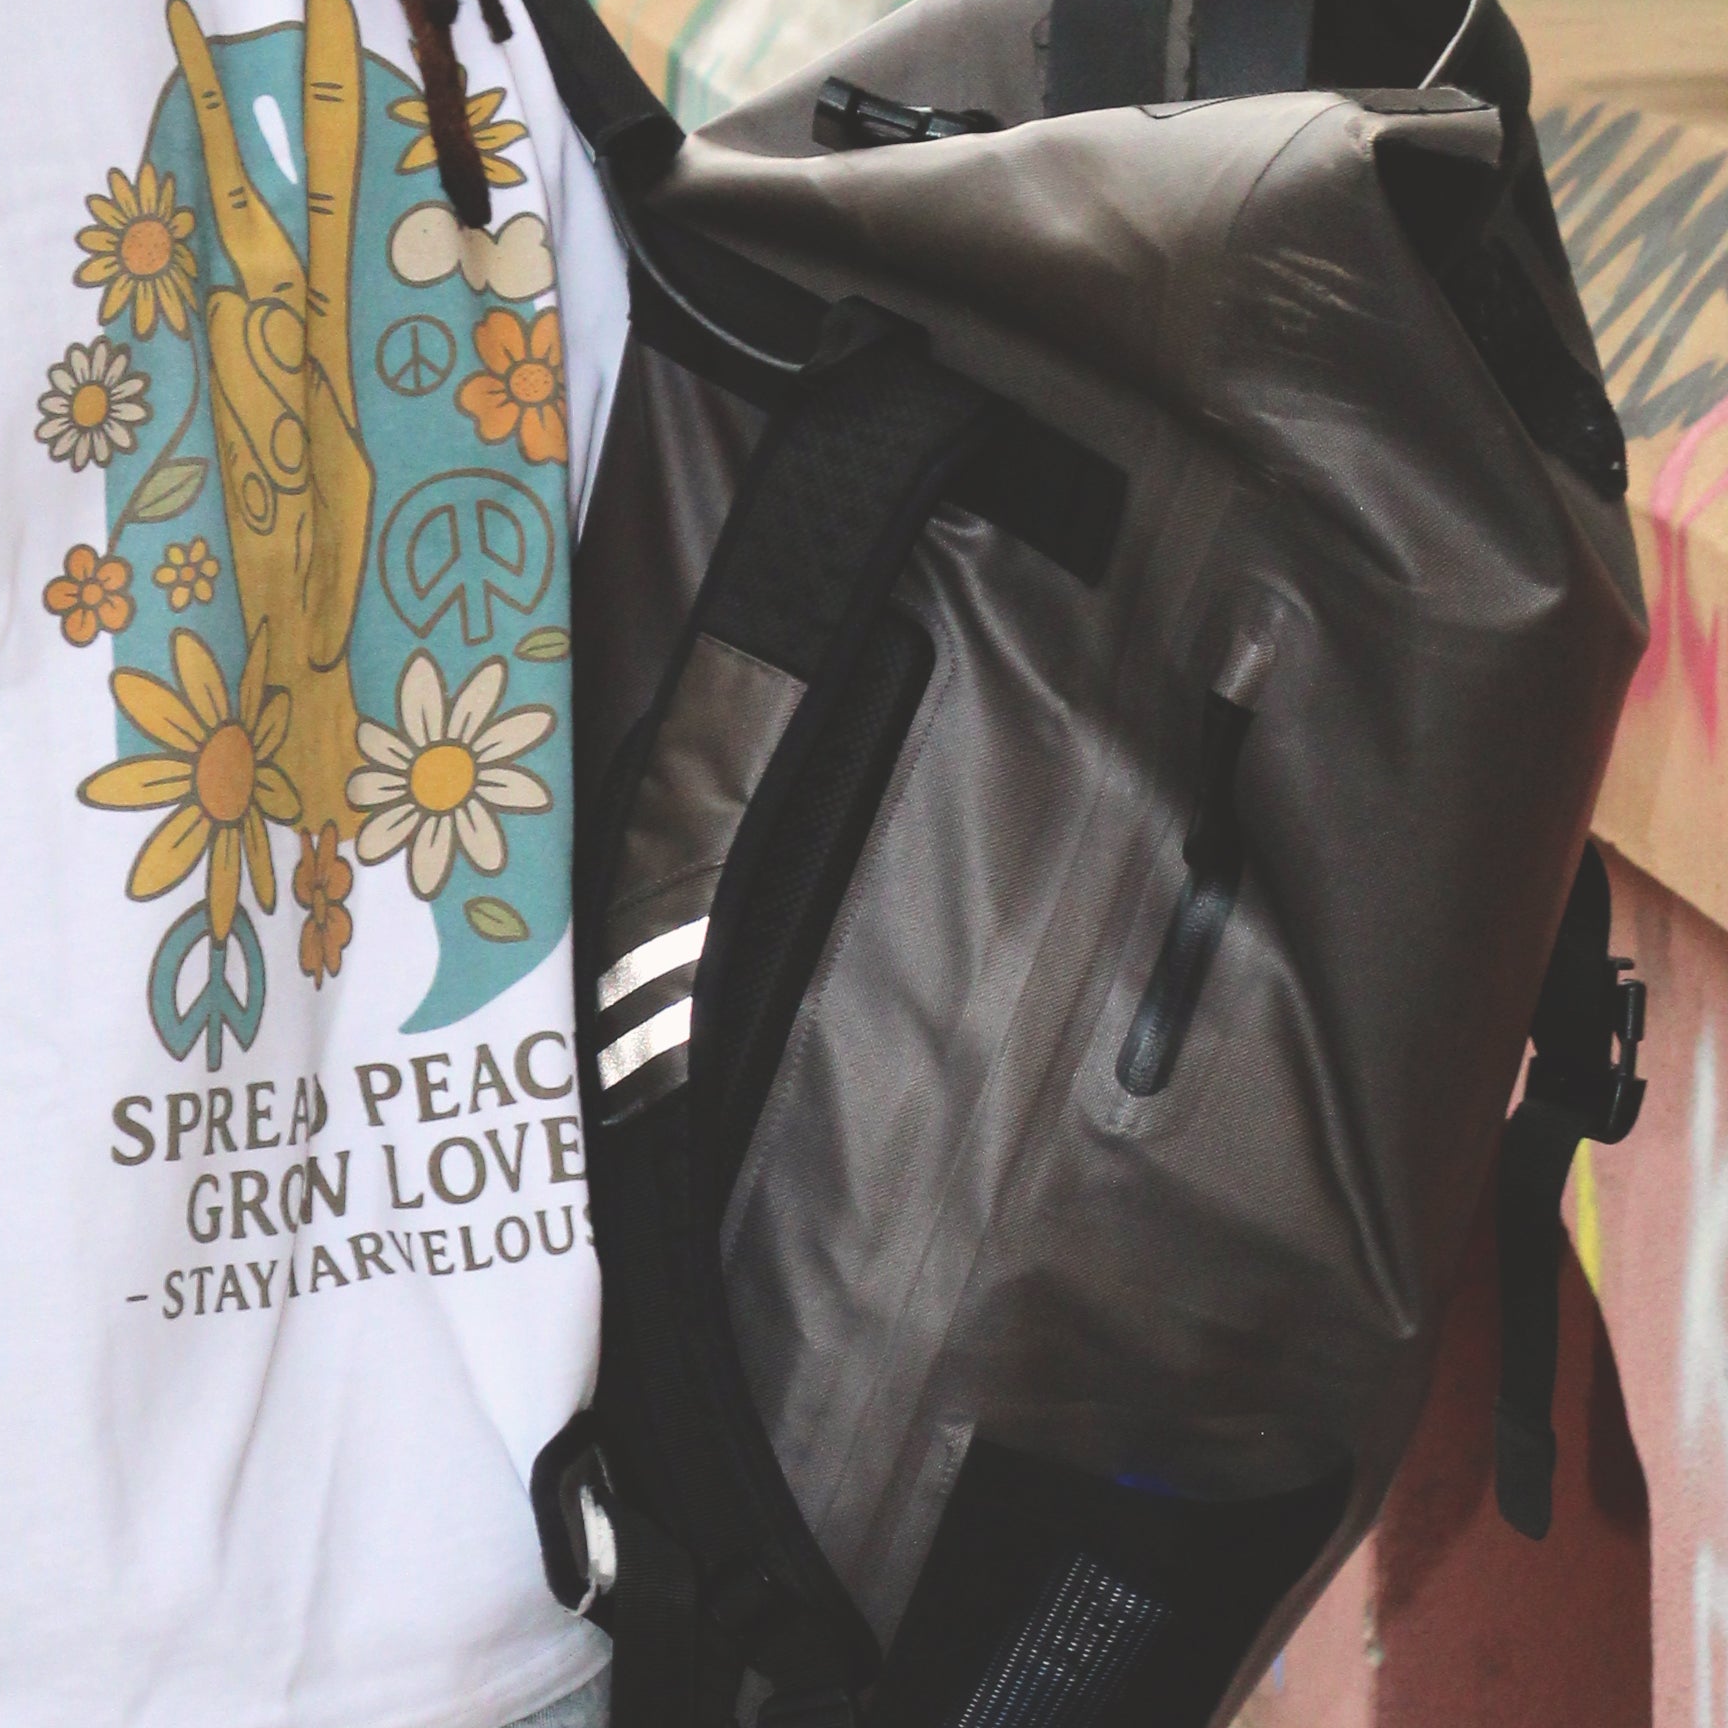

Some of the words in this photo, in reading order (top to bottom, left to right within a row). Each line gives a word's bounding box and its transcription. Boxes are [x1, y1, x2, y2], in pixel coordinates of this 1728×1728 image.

[354, 1029, 576, 1127] PEAC
[382, 1114, 587, 1211] LOVE
[162, 1258, 278, 1320] STAY
[288, 1202, 595, 1299] ARVELOU
